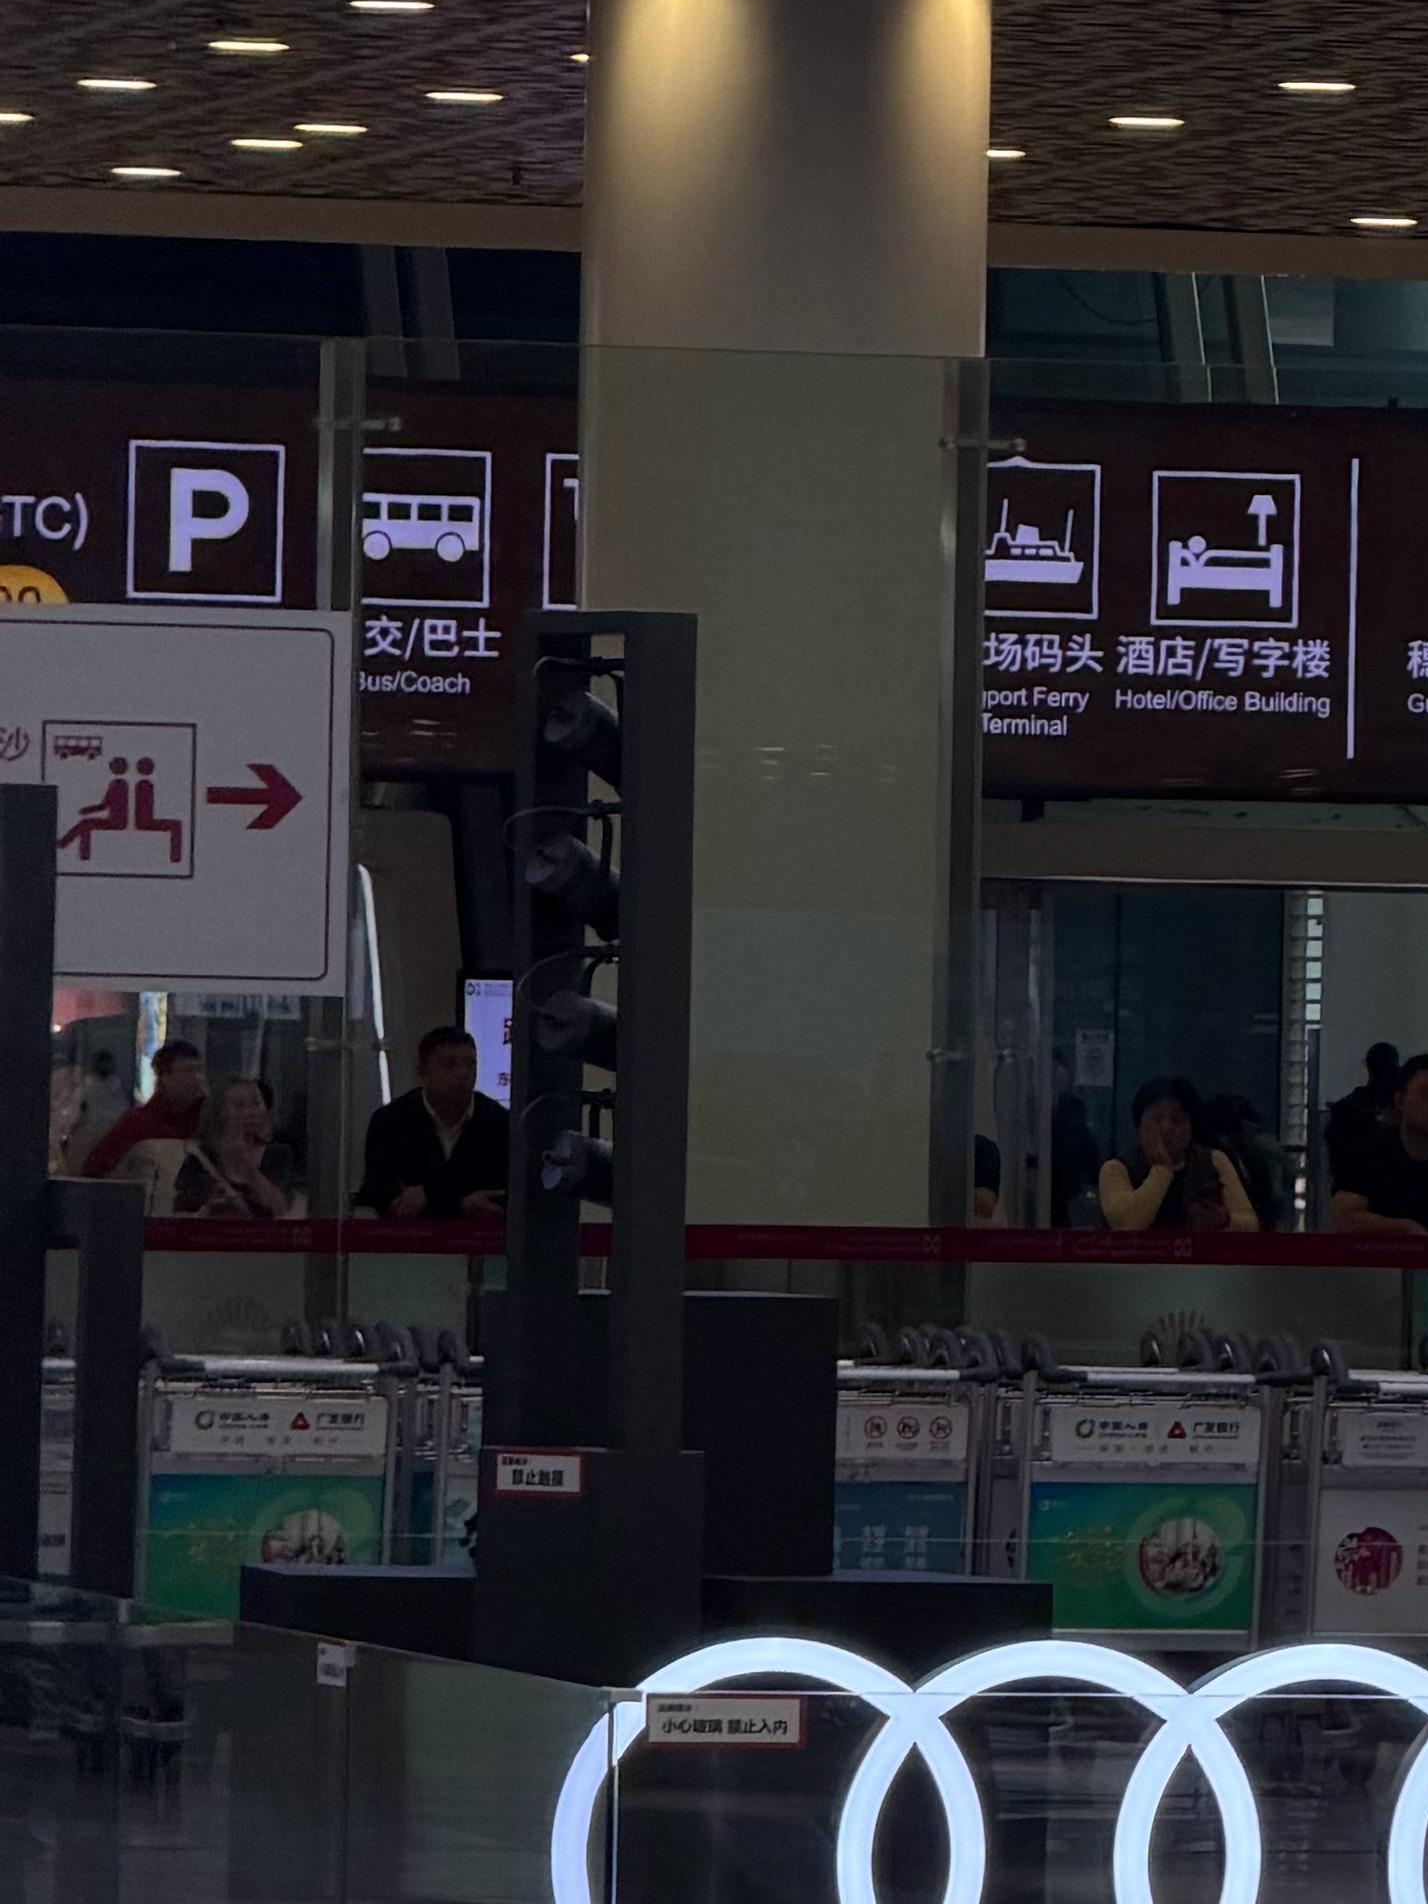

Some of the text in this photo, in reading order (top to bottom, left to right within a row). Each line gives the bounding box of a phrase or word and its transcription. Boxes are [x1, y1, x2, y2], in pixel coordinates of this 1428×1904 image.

[0, 491, 89, 551] TC)
[168, 467, 250, 573] P
[363, 614, 502, 661] 交/巴士
[982, 631, 1104, 673] 场码头
[1116, 635, 1331, 681] 酒店/写字楼
[982, 686, 1090, 714] port Ferry
[1115, 688, 1331, 719] Hotel/Office Building
[981, 712, 1068, 736] Terminal
